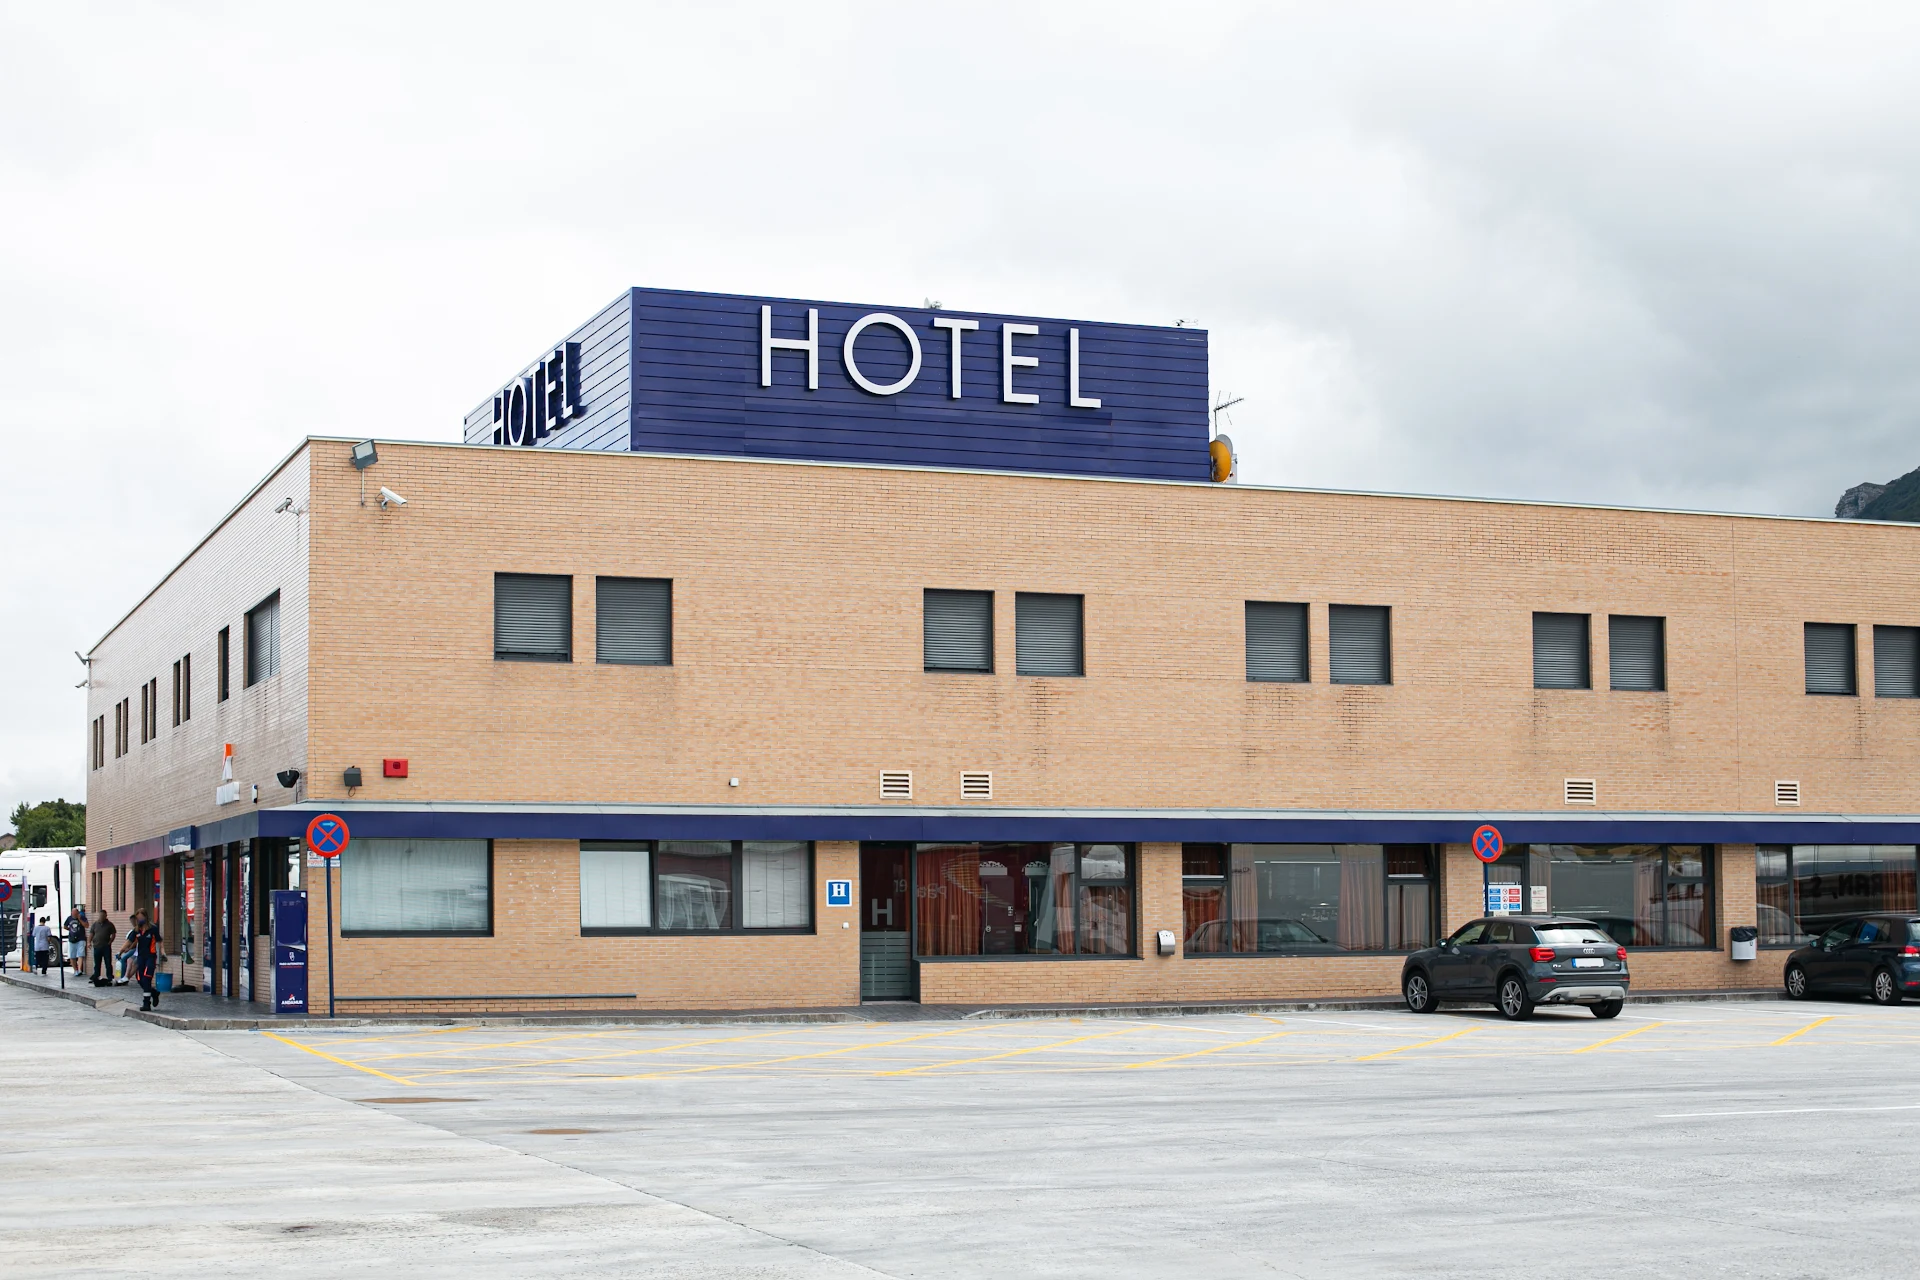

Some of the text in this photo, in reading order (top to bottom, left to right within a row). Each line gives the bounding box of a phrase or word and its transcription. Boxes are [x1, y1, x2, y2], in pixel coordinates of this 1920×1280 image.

[761, 305, 1102, 409] HOTEL
[492, 342, 578, 446] HOTEL
[831, 883, 847, 897] H
[871, 898, 893, 926] H
